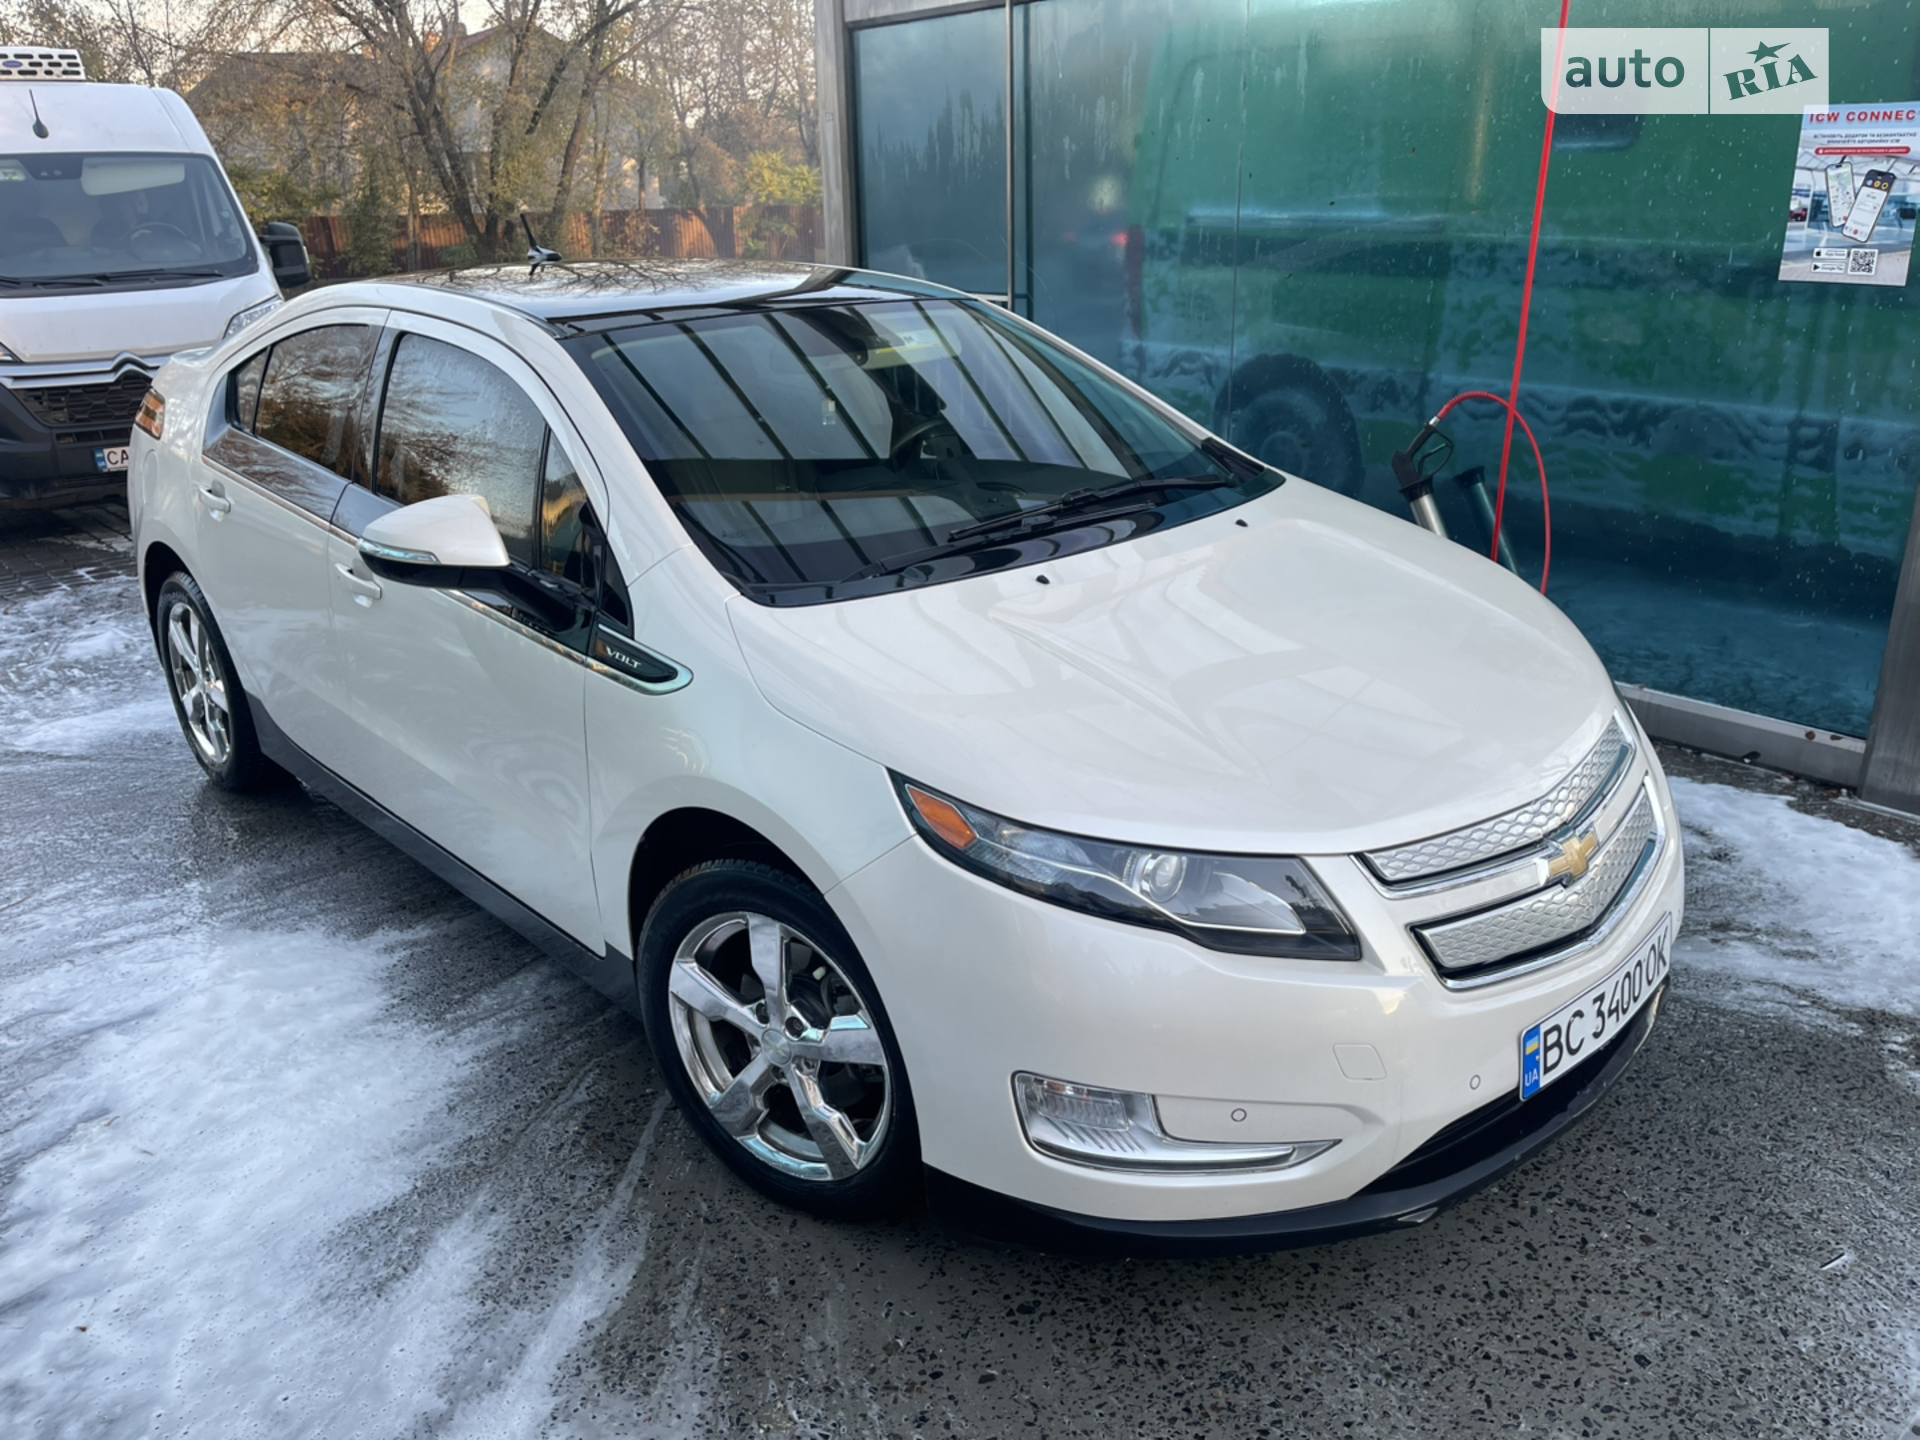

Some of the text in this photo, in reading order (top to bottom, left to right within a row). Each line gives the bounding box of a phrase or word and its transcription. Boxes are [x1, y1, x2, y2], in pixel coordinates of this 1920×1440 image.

[1809, 109, 1920, 123] ICW CONNEC
[606, 645, 641, 669] VOLT
[1543, 925, 1669, 1076] BC 3400 OK
[1525, 1068, 1539, 1087] UA
